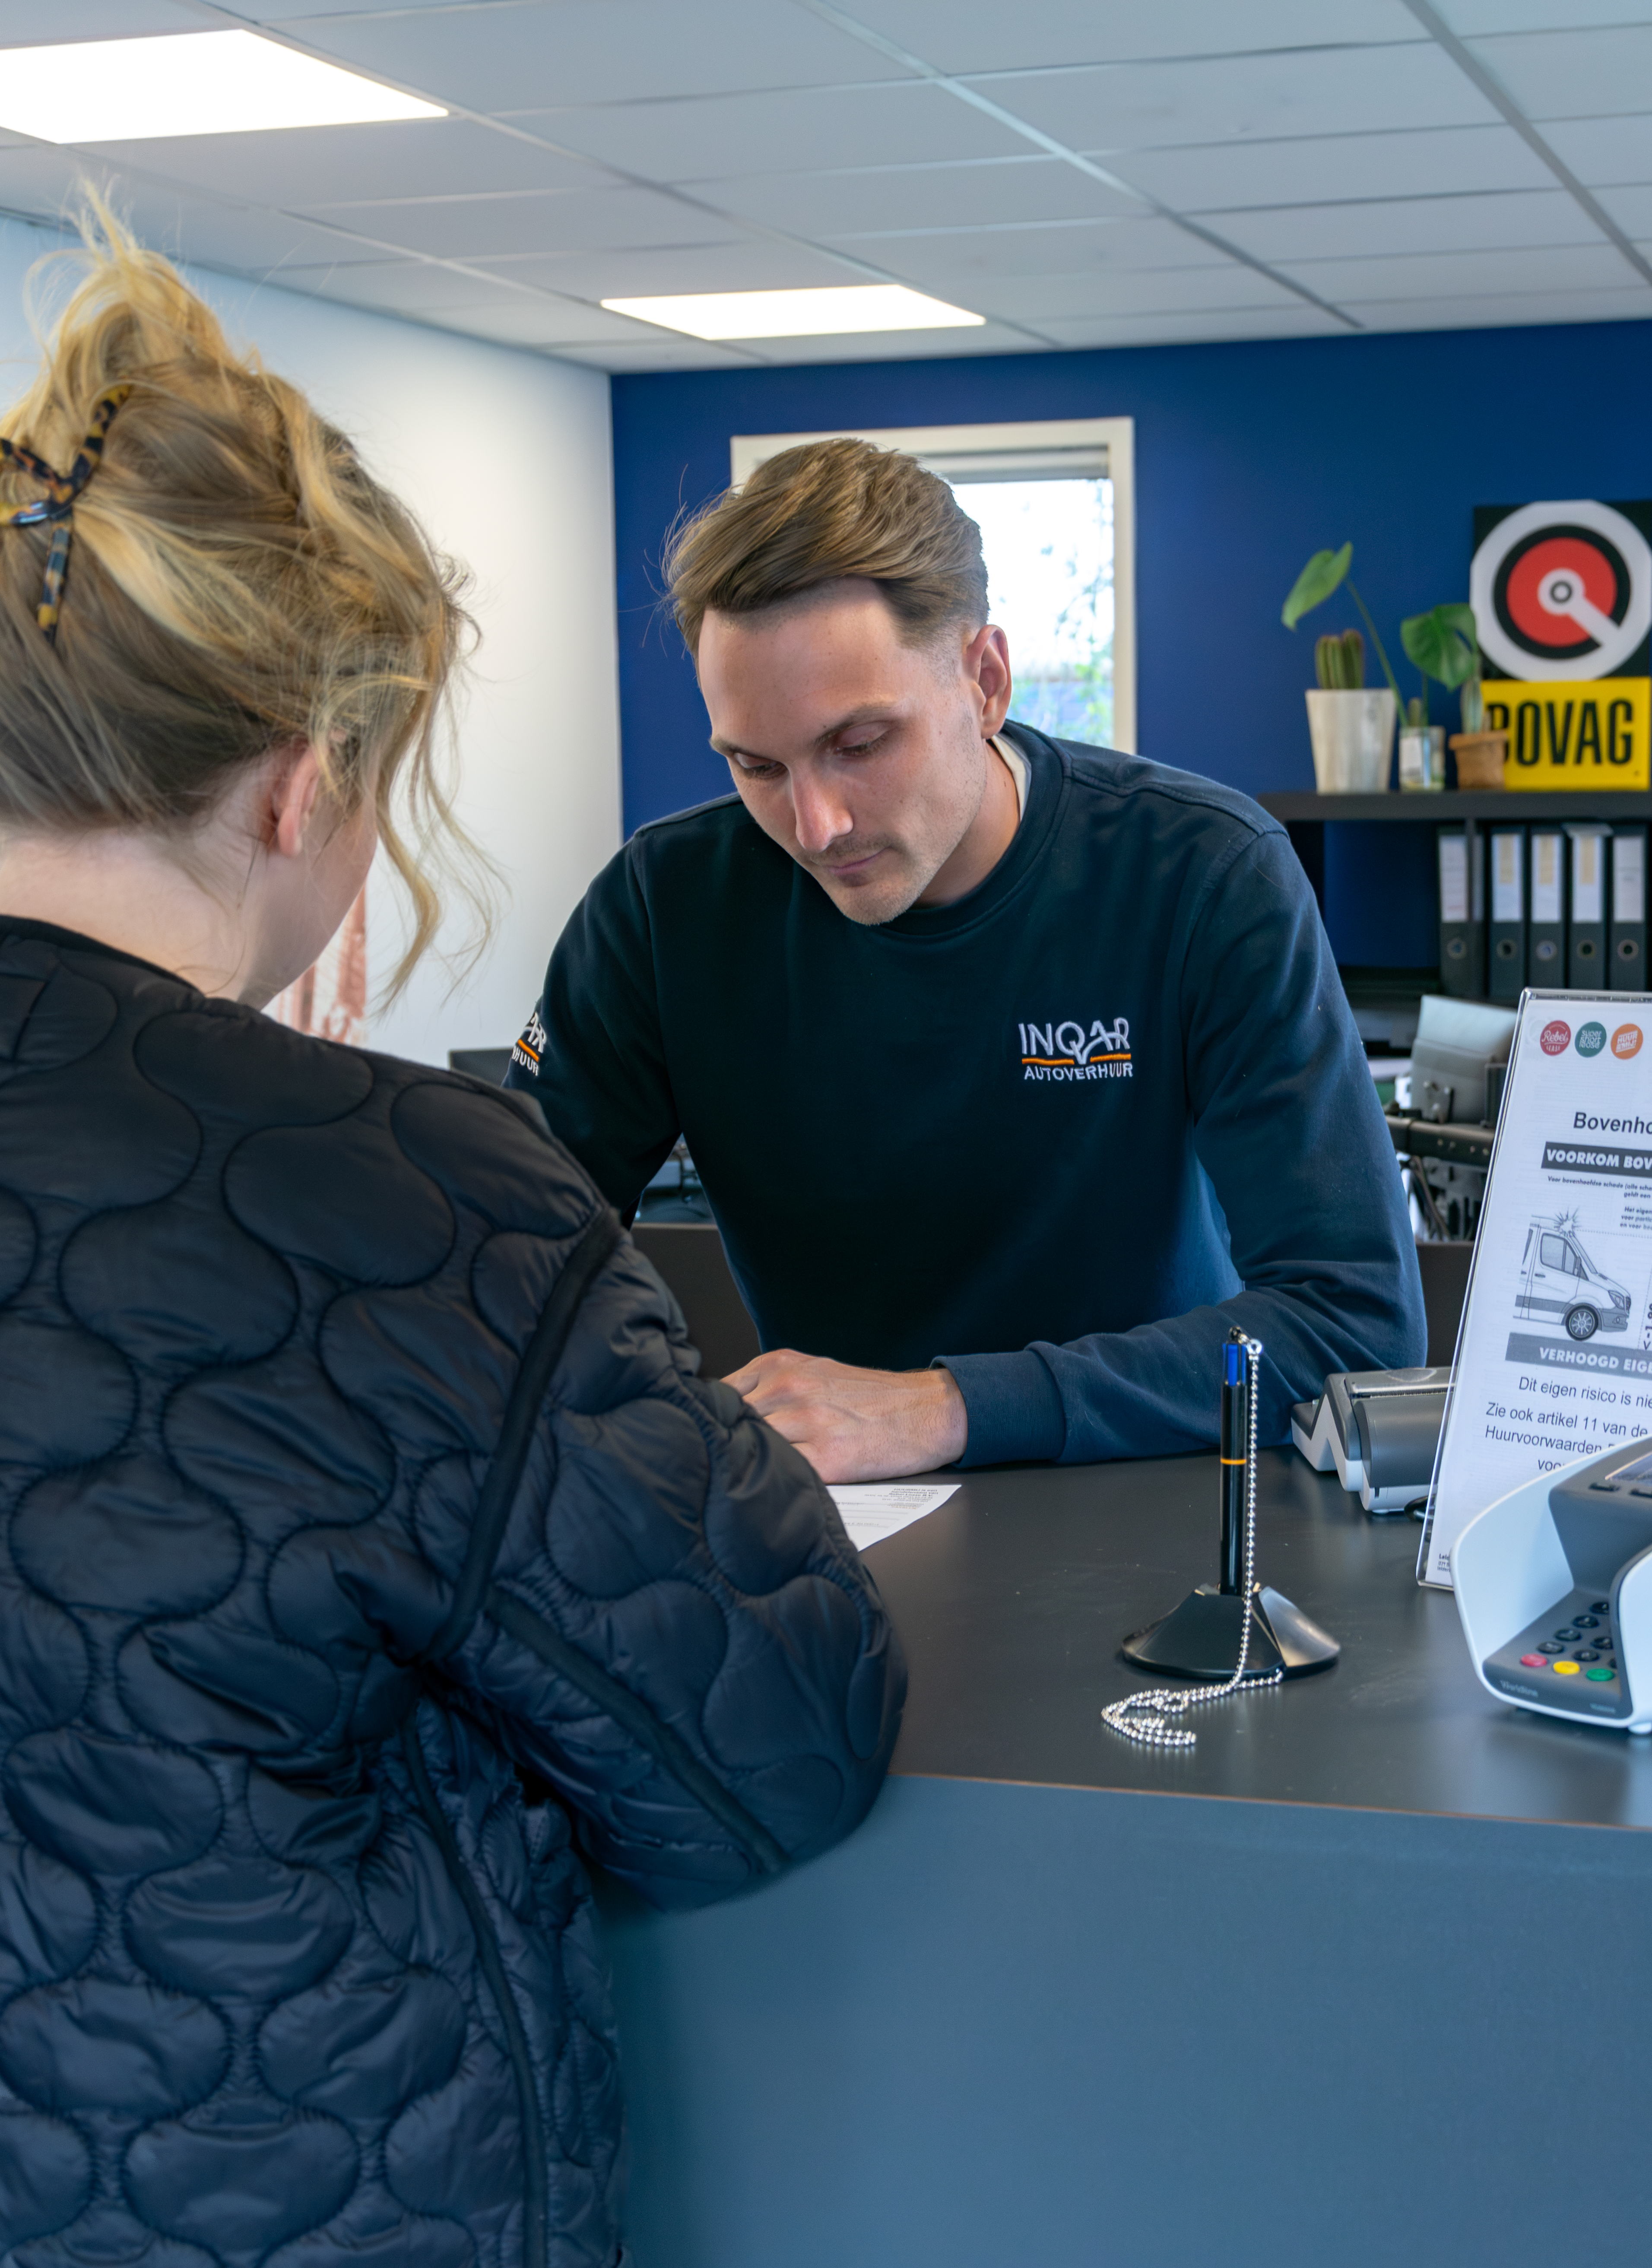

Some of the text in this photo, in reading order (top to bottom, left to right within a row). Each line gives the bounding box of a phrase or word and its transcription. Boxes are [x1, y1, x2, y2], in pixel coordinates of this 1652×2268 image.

[1018, 1017, 1130, 1064] INQAR
[1541, 1030, 1568, 1042] Rebel
[1024, 1062, 1133, 1081] AUTOVERHUUR
[1573, 1112, 1652, 1135] Bovenho
[1547, 1149, 1652, 1170] VOORKOM BOV
[1562, 1177, 1601, 1186] bovenhoofdse
[1539, 1347, 1652, 1374] VERHOOGD EIGE
[1519, 1377, 1652, 1408] Dit eigen risico is nie
[1486, 1402, 1648, 1438] Zie ook artikel 11 van de
[1485, 1425, 1601, 1454] Huurvoorwaarden
[1538, 1459, 1564, 1471] voo
